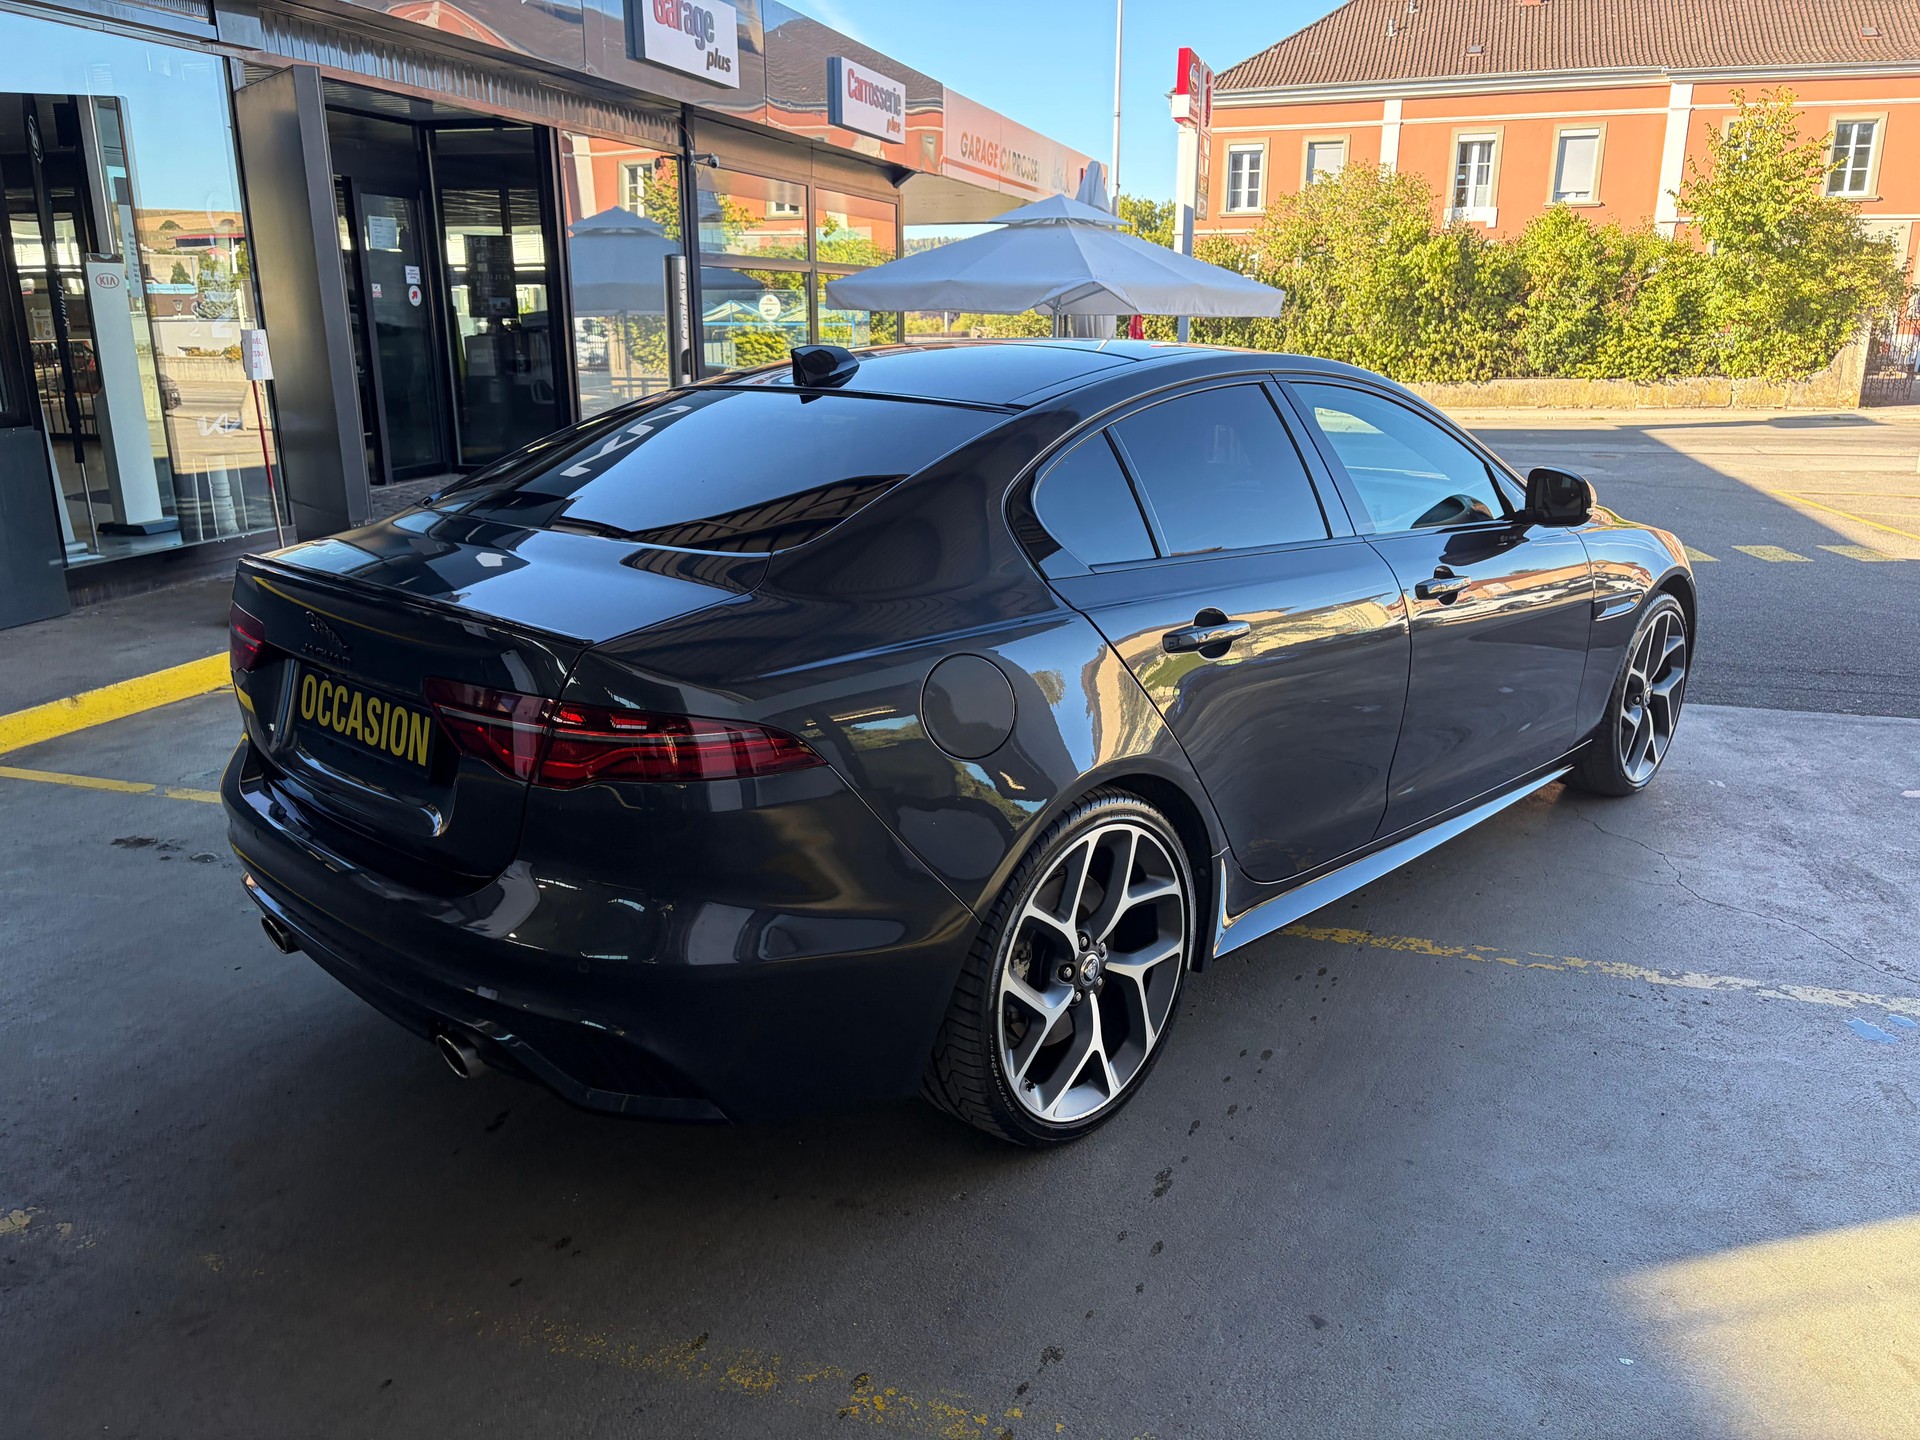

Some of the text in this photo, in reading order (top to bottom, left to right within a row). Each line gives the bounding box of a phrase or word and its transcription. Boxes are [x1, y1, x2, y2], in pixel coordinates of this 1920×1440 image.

[706, 47, 731, 72] plus
[847, 68, 901, 116] Carrosserie
[886, 116, 901, 133] plus
[960, 131, 999, 168] GARAGE
[97, 274, 118, 287] KIA
[301, 674, 430, 766] OCCASION
